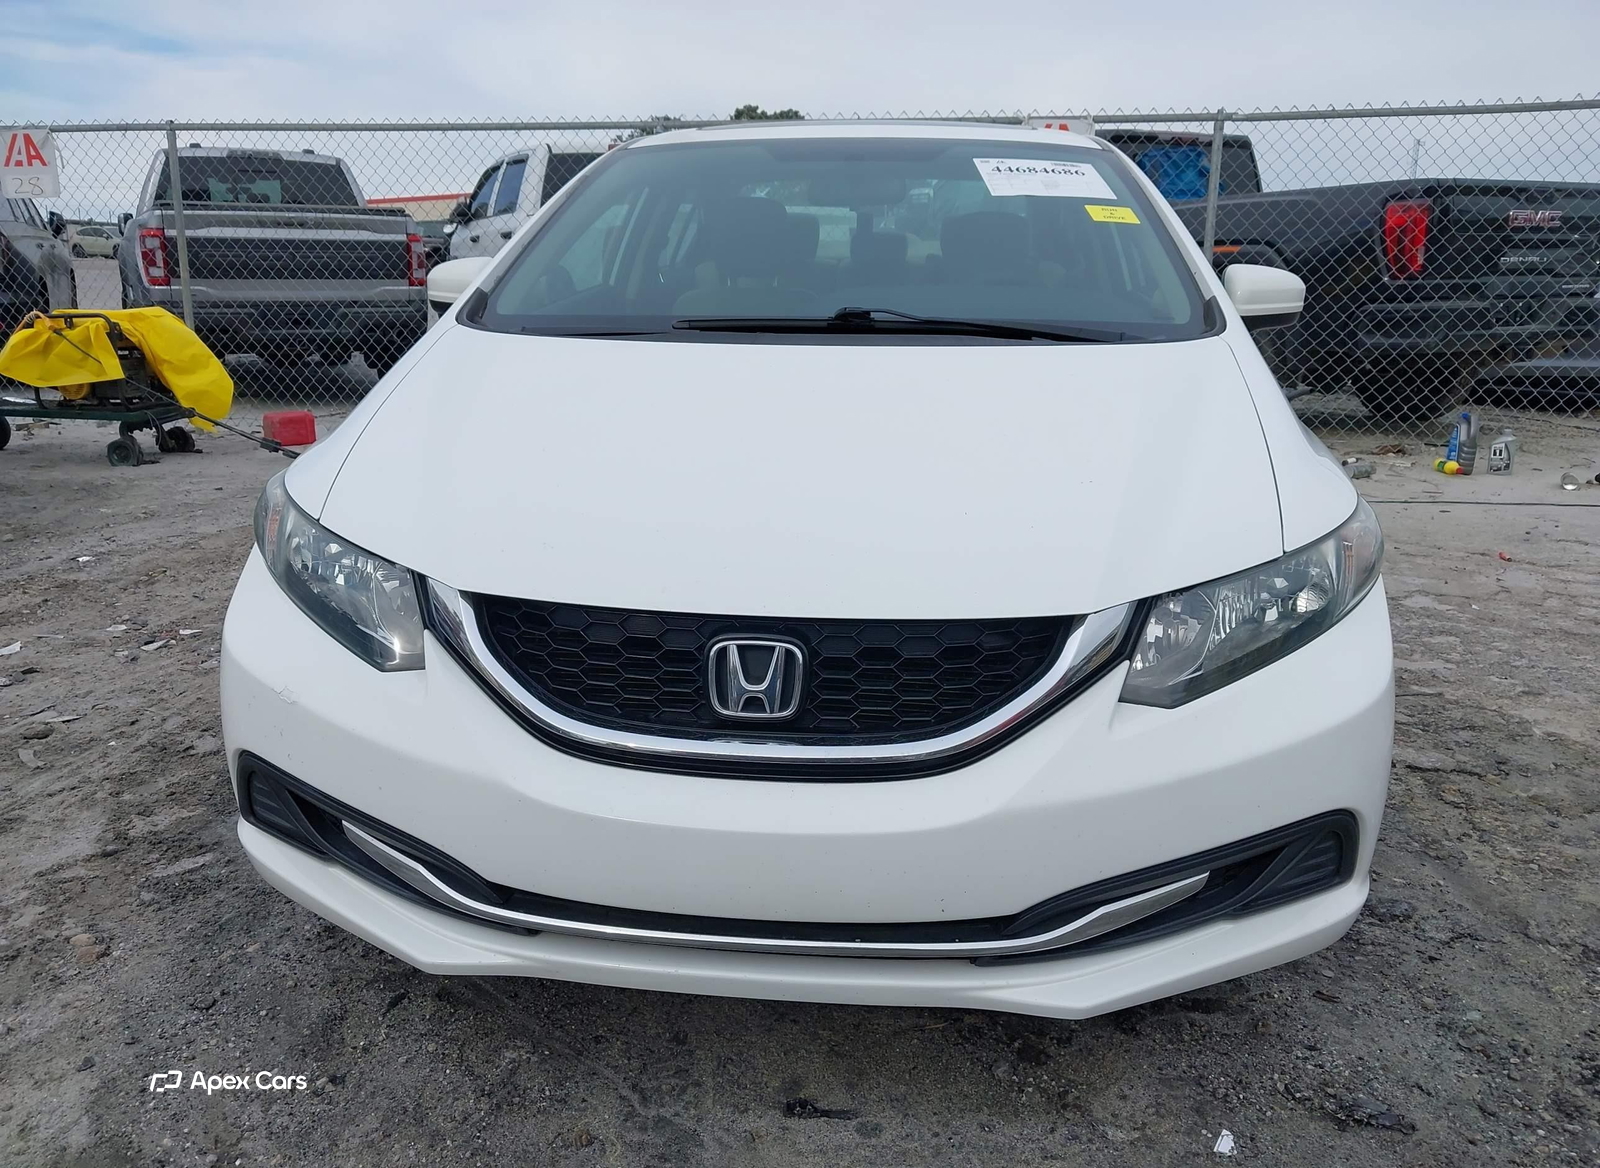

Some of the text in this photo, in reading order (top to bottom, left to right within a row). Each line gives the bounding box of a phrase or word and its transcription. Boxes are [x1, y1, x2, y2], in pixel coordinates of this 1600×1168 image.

[991, 165, 1086, 177] 44684686
[12, 177, 44, 196] 28
[1509, 210, 1562, 226] GMC
